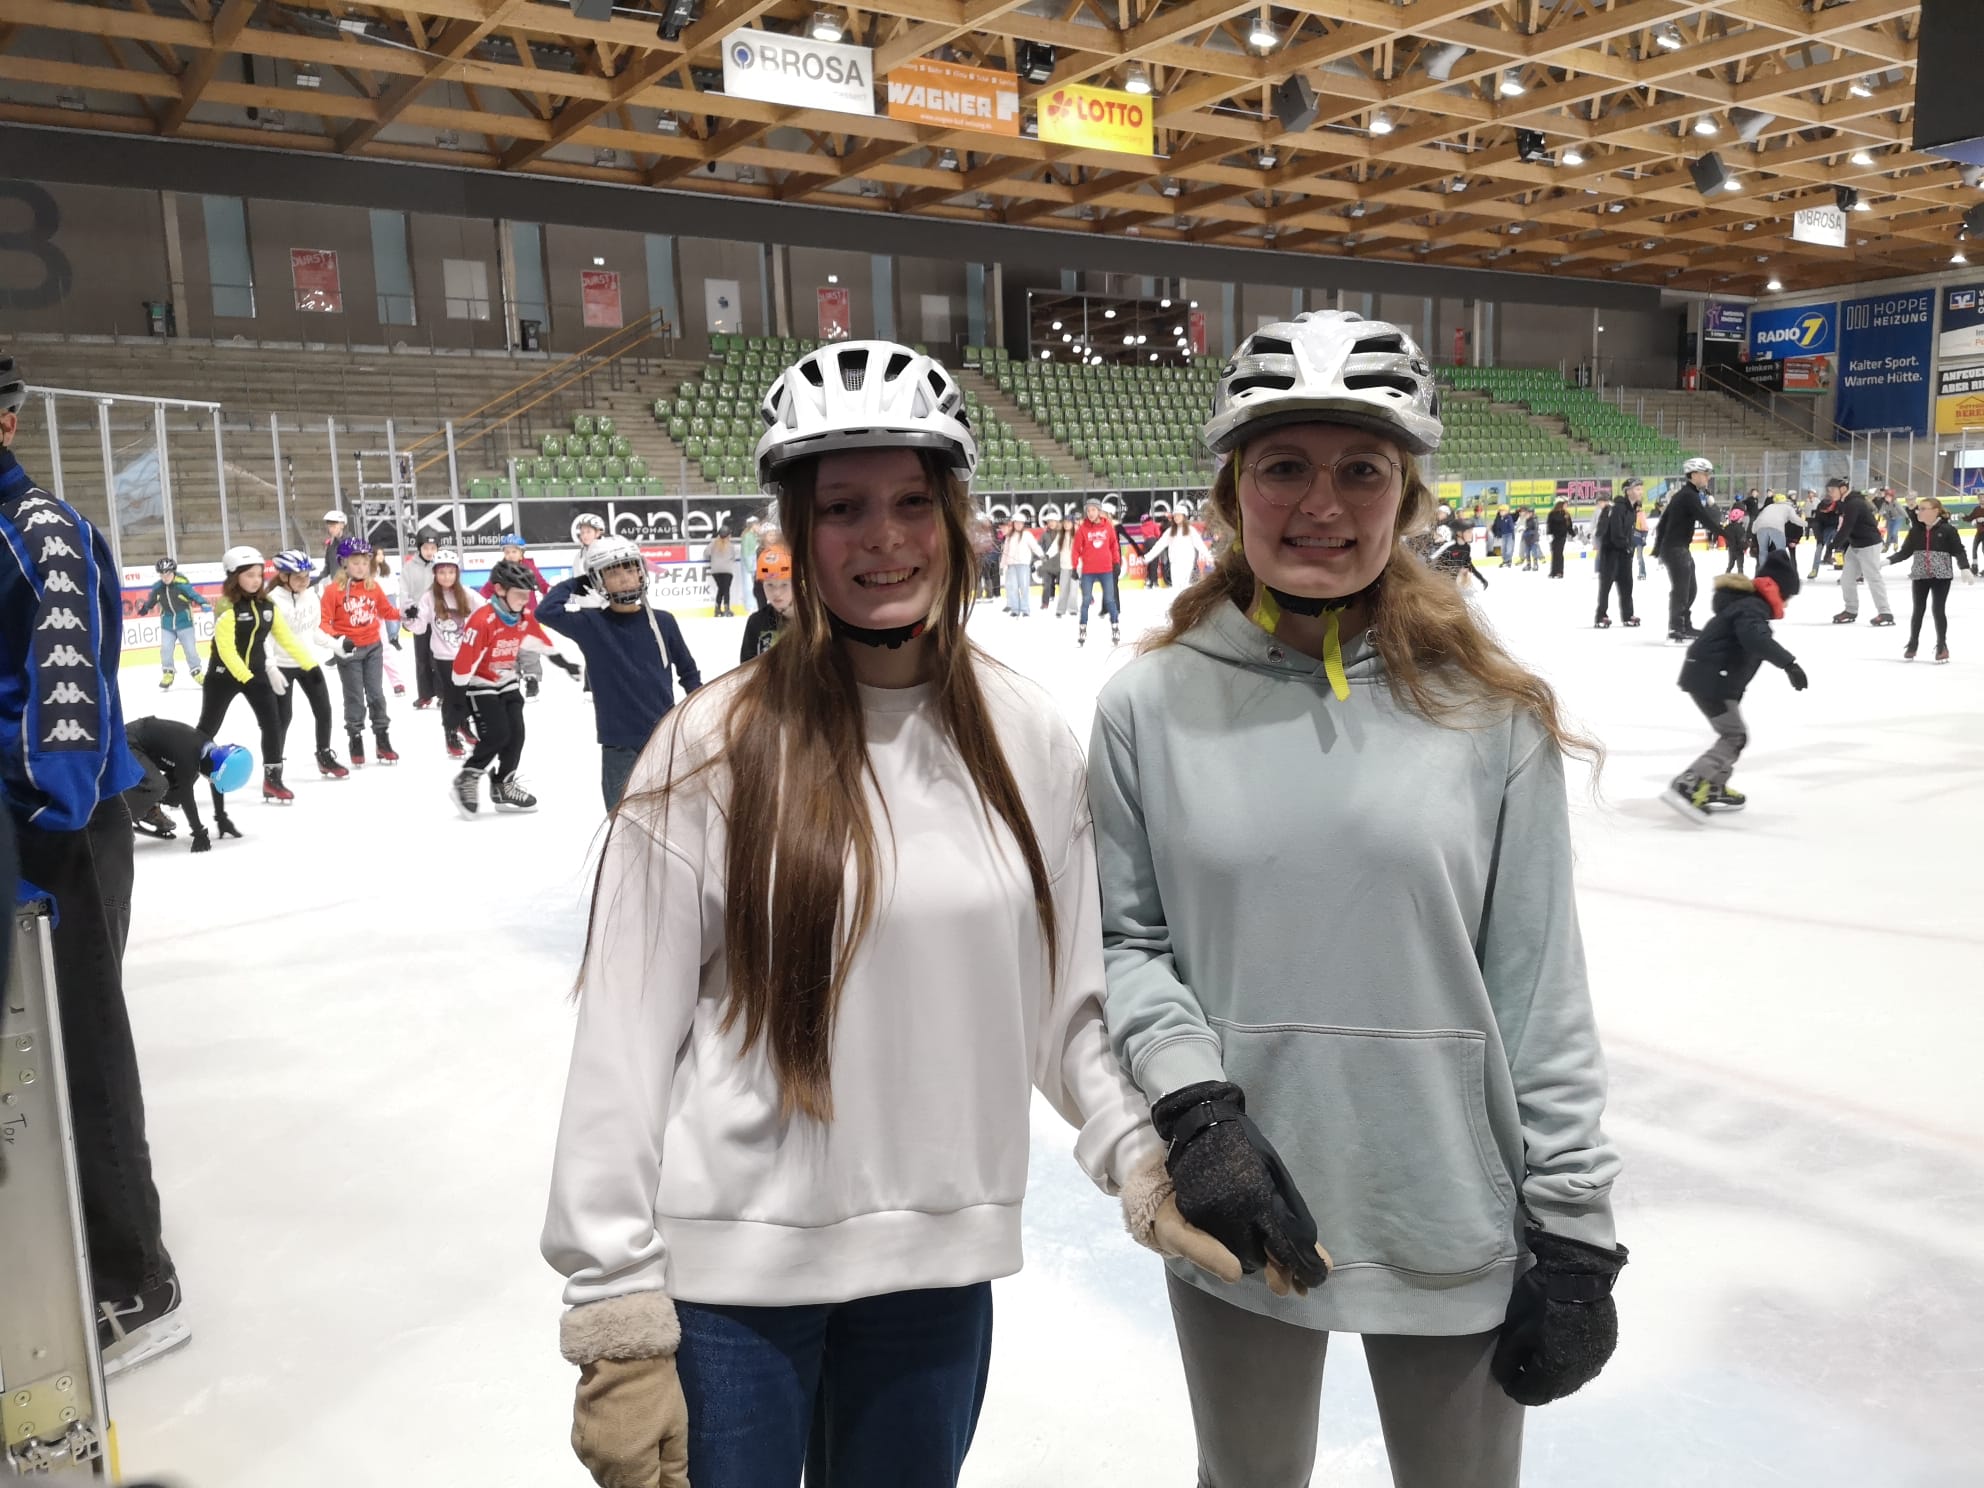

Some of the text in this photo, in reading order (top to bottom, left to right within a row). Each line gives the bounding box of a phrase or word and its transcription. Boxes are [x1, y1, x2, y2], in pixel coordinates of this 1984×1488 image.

[760, 45, 864, 87] BROSA
[888, 81, 992, 118] WAGNER
[1077, 96, 1143, 128] LOTTO
[1807, 210, 1842, 230] BROSA
[1874, 297, 1928, 315] HOPPE
[1873, 312, 1928, 327] HEIZUNG
[1757, 317, 1825, 346] RADIO 7
[1849, 355, 1919, 371] Kalter Sport.
[1844, 371, 1922, 387] Warme Hütte.
[621, 526, 678, 535] AUTOHAUS
[655, 585, 711, 596] LOGISTIK
